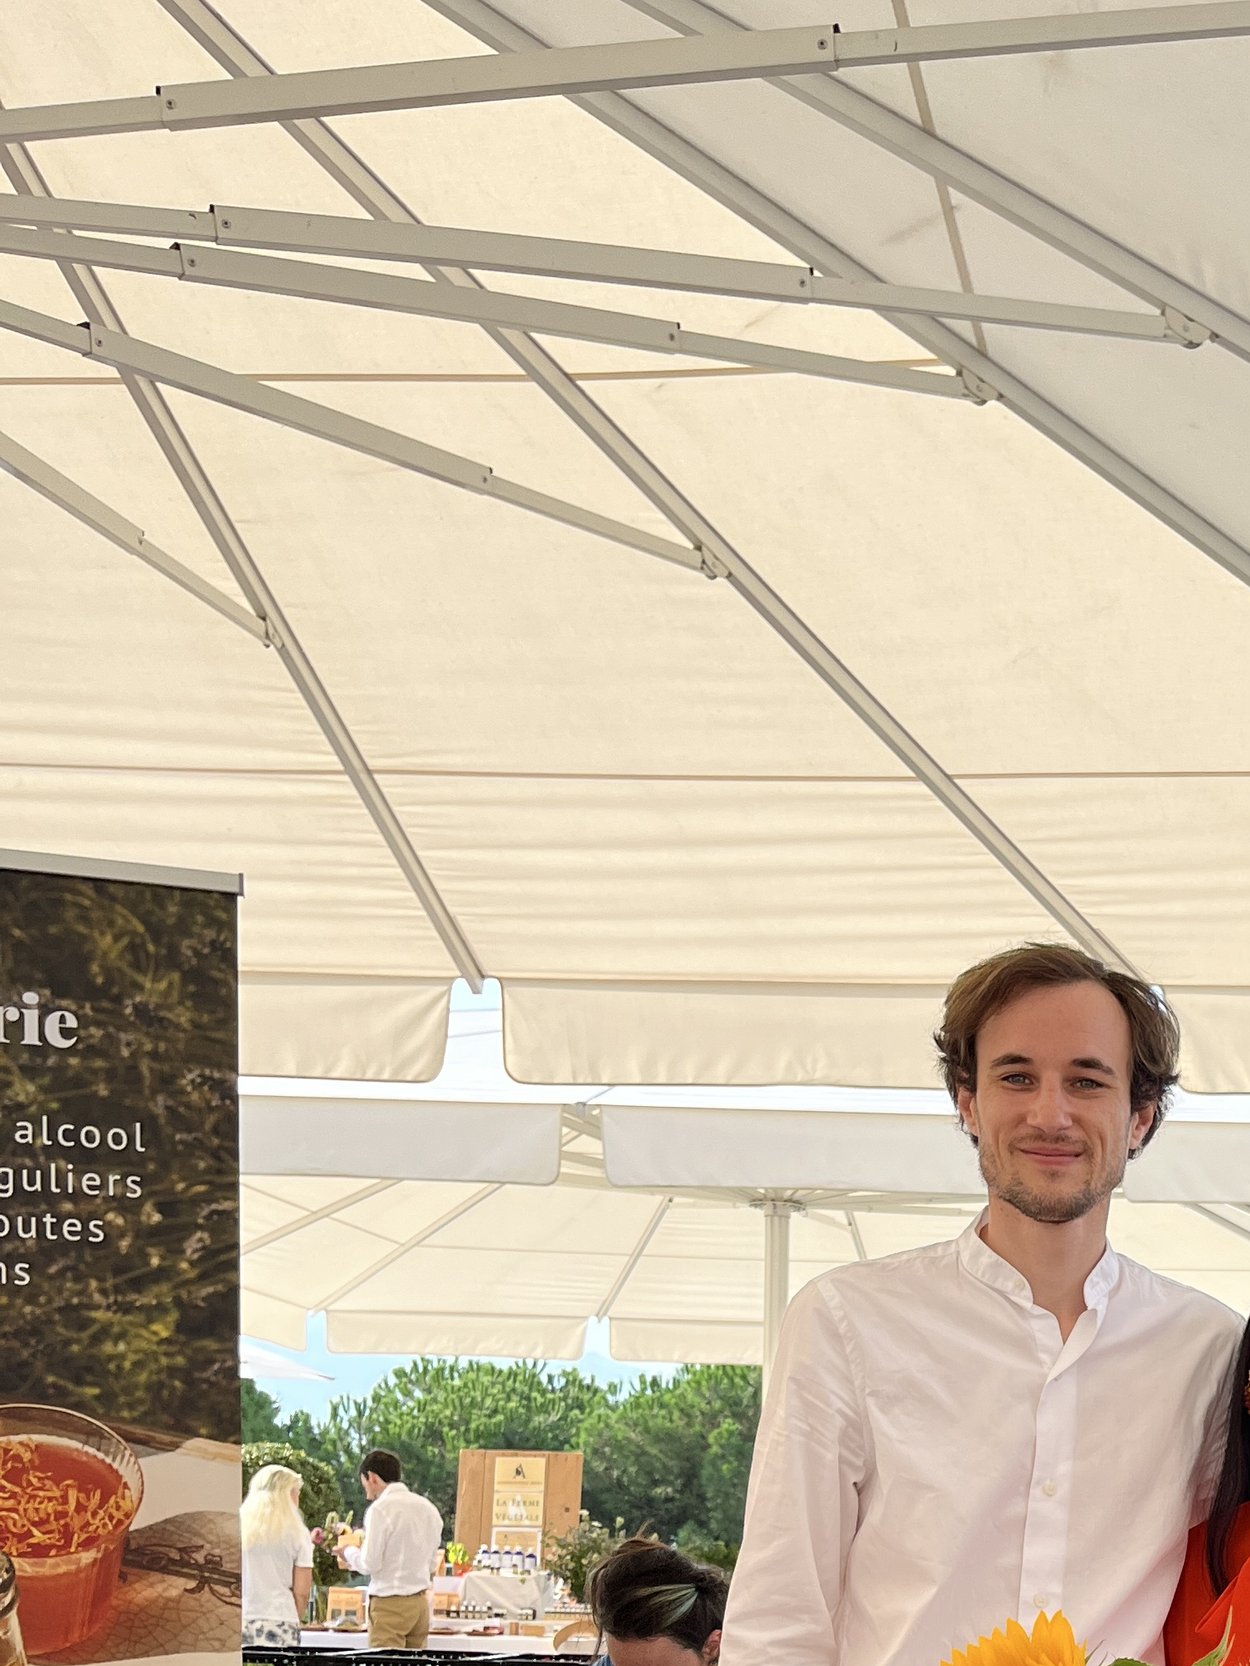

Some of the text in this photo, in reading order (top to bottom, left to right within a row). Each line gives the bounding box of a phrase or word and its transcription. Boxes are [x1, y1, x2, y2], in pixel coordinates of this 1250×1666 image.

[0, 991, 79, 1049] rie
[14, 1115, 146, 1152] alcool
[0, 1164, 142, 1199] guliers
